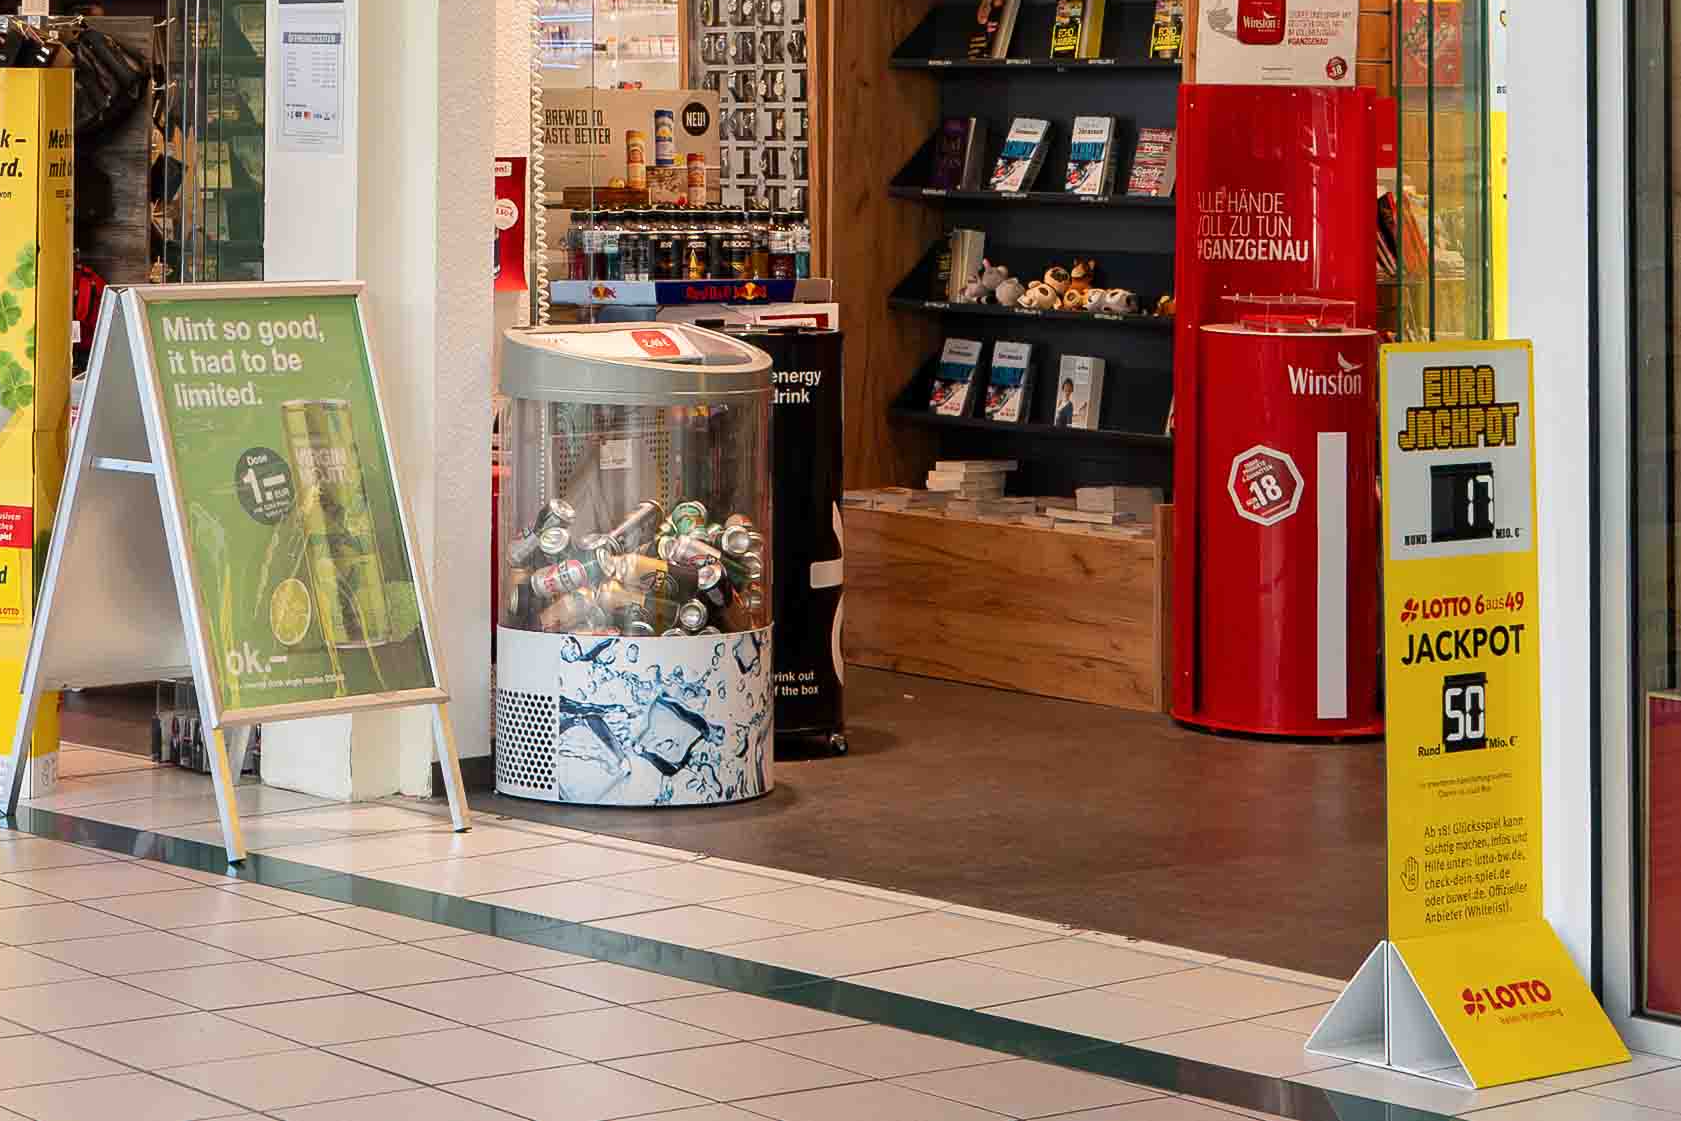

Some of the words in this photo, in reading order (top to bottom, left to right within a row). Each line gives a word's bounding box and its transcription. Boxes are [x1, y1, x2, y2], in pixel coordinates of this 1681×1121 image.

[1242, 16, 1277, 30] Winston
[545, 109, 588, 126] BREWED
[592, 109, 604, 126] TO
[686, 111, 706, 128] NEU!
[574, 127, 611, 145] BETTER
[48, 157, 67, 178] mit
[1228, 187, 1285, 215] HÄNDE
[1229, 215, 1251, 237] ZU
[1256, 215, 1292, 238] TUN
[161, 316, 219, 343] Mint
[223, 320, 251, 342] so
[258, 312, 326, 346] good,
[168, 349, 187, 375] it
[190, 348, 237, 375] had
[241, 349, 267, 373] to
[271, 346, 305, 372] be
[771, 370, 821, 386] energy
[1287, 363, 1363, 396] Winston
[1423, 365, 1496, 408] EURO
[173, 381, 263, 410] limited.
[1398, 402, 1520, 451] JACKPOT
[1249, 474, 1283, 507] 18
[1404, 533, 1427, 546] RUND
[1422, 596, 1472, 619] LOTTO
[1400, 623, 1525, 666] JACKPOT
[774, 670, 796, 682] rink
[798, 670, 815, 681] out
[781, 685, 799, 697] the
[801, 685, 819, 696] box
[1445, 685, 1485, 741] 50
[1418, 744, 1441, 758] Rund
[1488, 737, 1508, 749] Mio.
[1424, 826, 1436, 838] Ab
[1425, 859, 1445, 872] Hilfe
[1425, 894, 1445, 907] oder
[1425, 909, 1463, 924] Anbieter
[1483, 979, 1552, 1009] LOTTO
